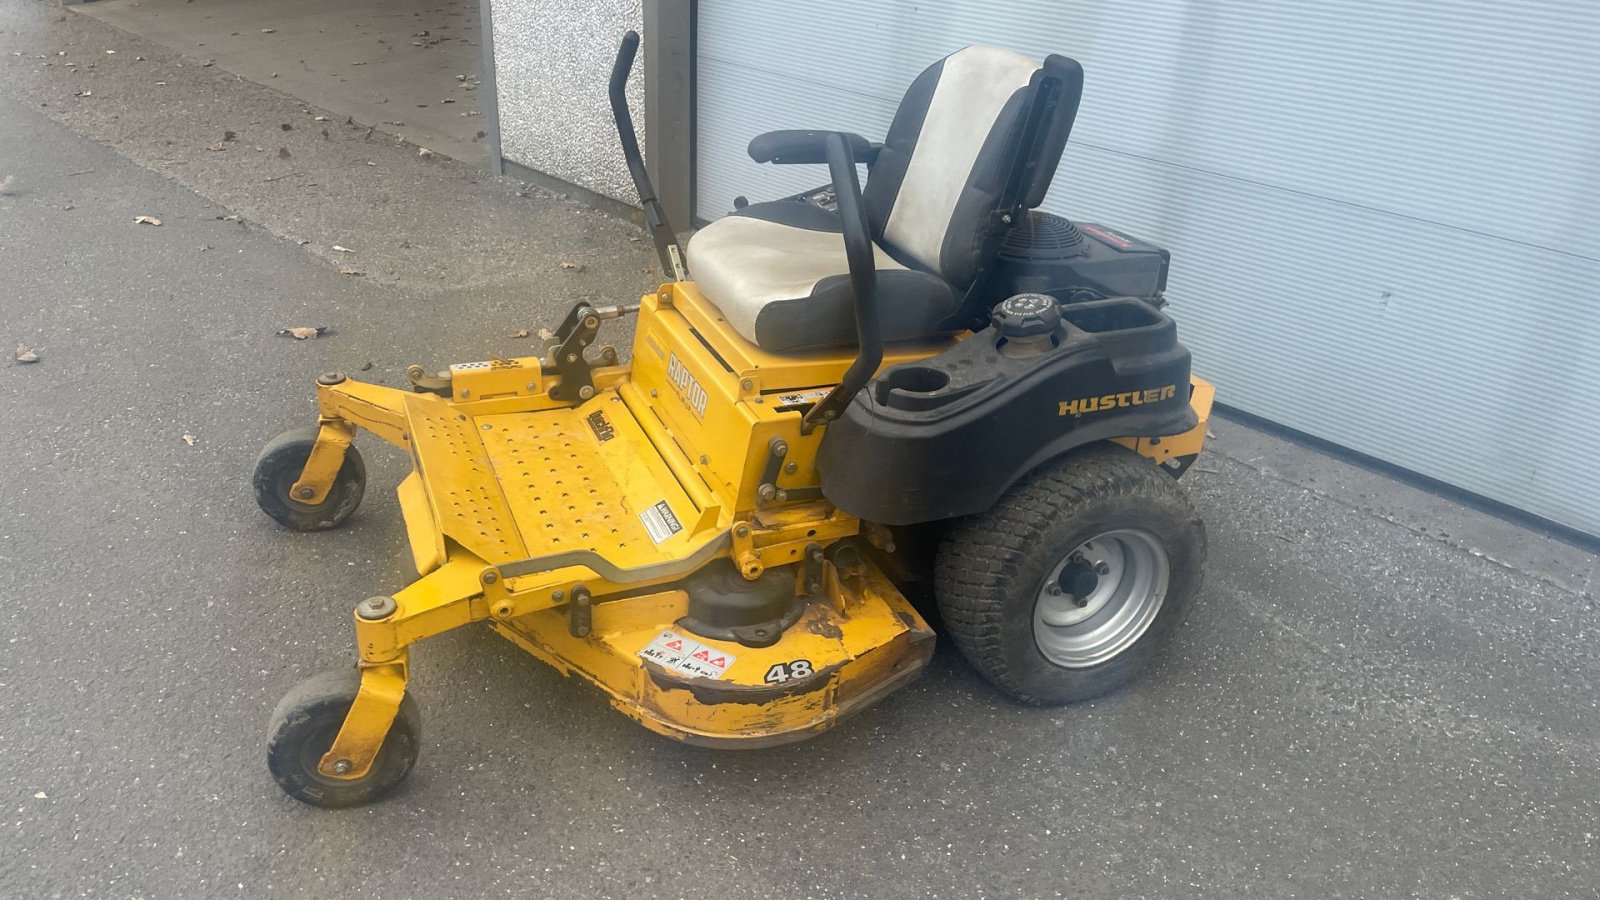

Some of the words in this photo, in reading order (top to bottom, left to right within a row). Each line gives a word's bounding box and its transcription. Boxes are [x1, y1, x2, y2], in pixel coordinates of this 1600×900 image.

[668, 351, 708, 418] RAPTOR
[1058, 384, 1176, 416] HUSTLER
[765, 660, 813, 684] 48
